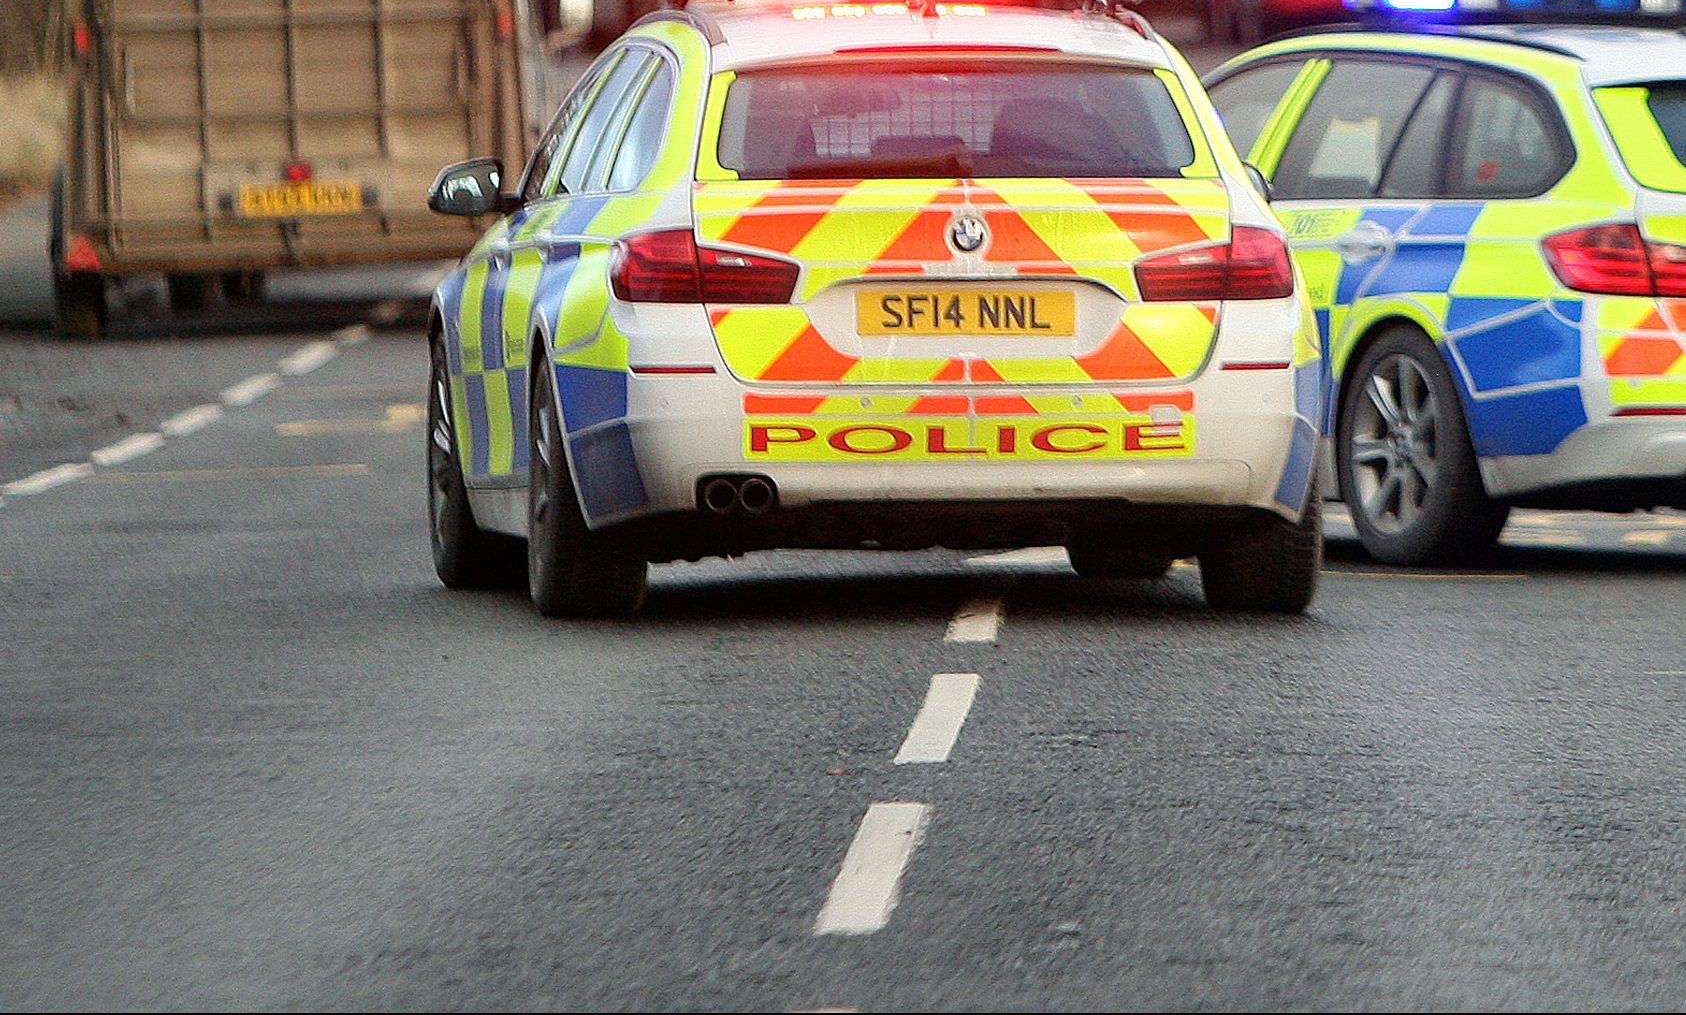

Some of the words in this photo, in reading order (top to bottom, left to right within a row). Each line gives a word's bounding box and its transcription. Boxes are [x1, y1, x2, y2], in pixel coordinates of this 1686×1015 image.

[881, 294, 964, 328] SF14
[978, 297, 1051, 329] NNL
[750, 421, 1185, 454] POLICE
